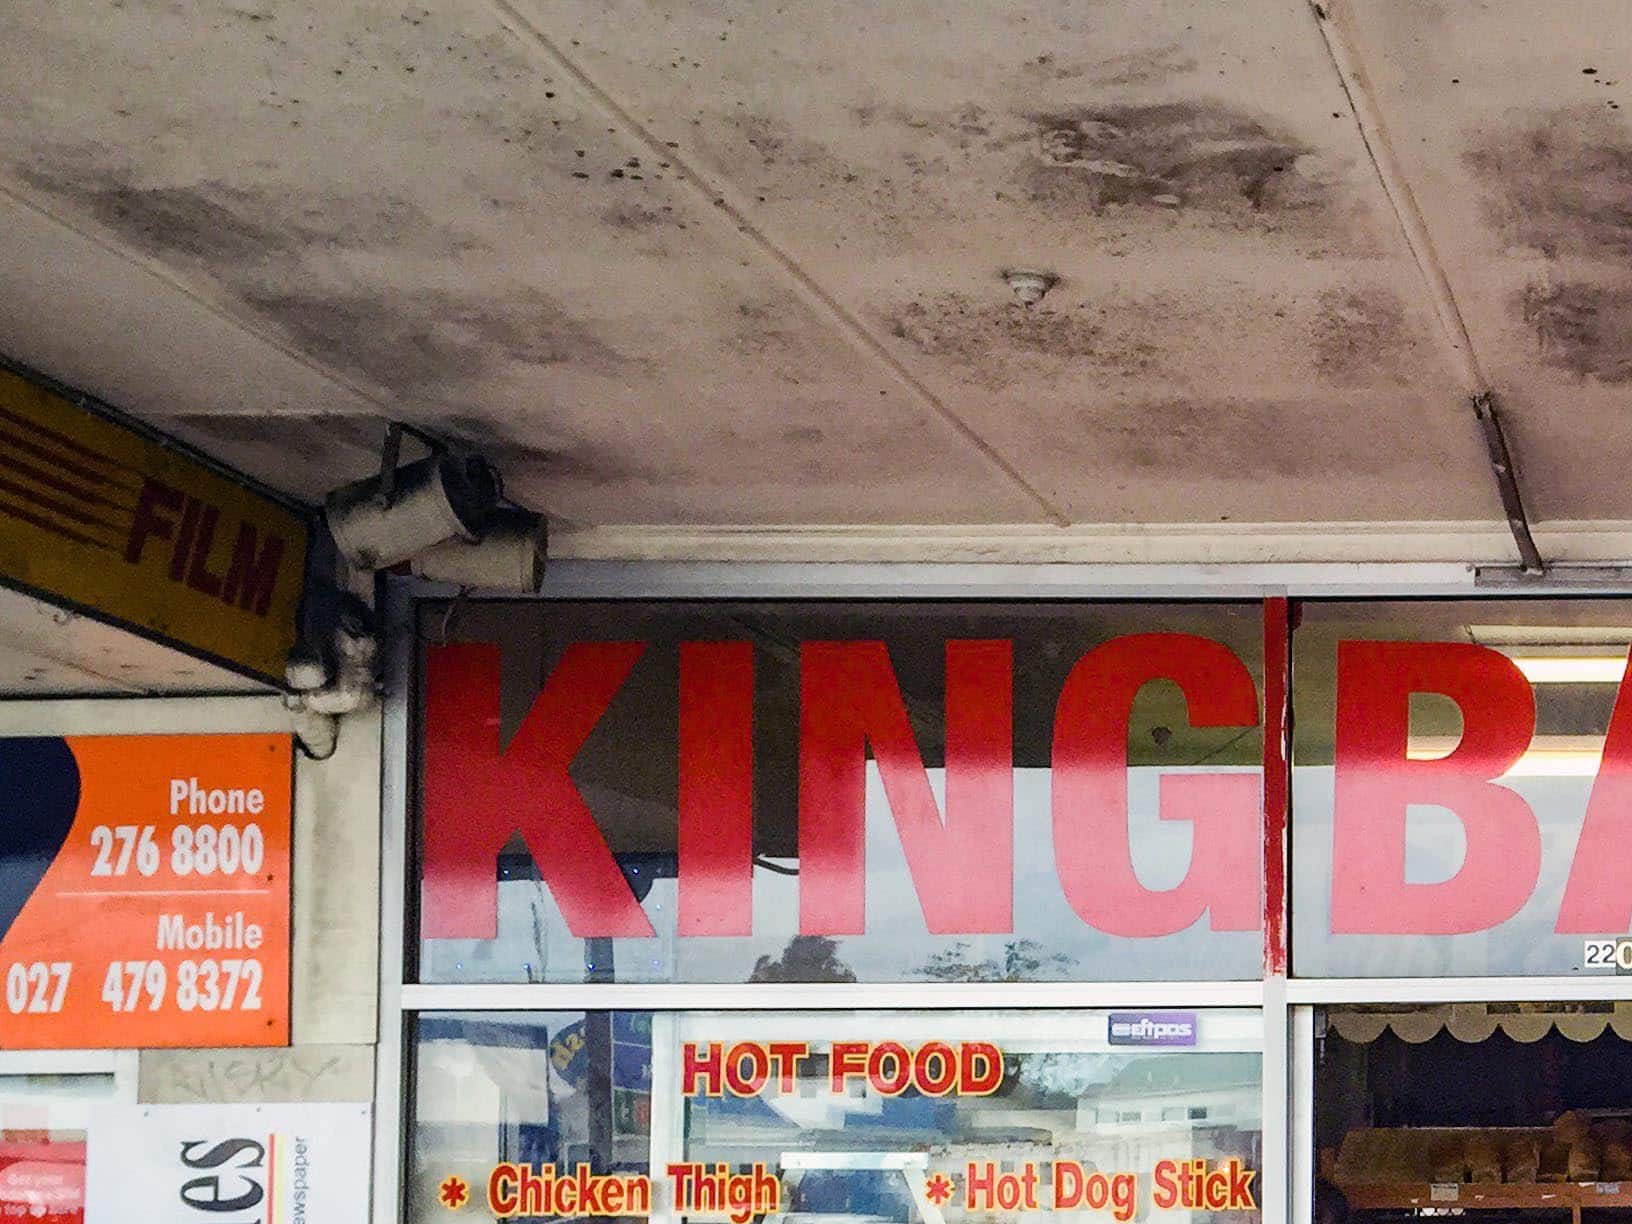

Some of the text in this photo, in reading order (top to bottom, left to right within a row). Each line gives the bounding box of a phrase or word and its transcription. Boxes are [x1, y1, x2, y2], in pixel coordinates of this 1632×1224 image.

[123, 476, 285, 618] FILM
[169, 777, 265, 815] Phone
[420, 632, 1262, 940] KING
[90, 823, 264, 877] 276 8800
[156, 912, 263, 950] Mobile
[6, 959, 262, 1014] 027 479 8372
[681, 1041, 1004, 1096] HOT FOOD
[488, 1162, 651, 1217] Chicken
[965, 1159, 1256, 1222] Hot Dog Stick
